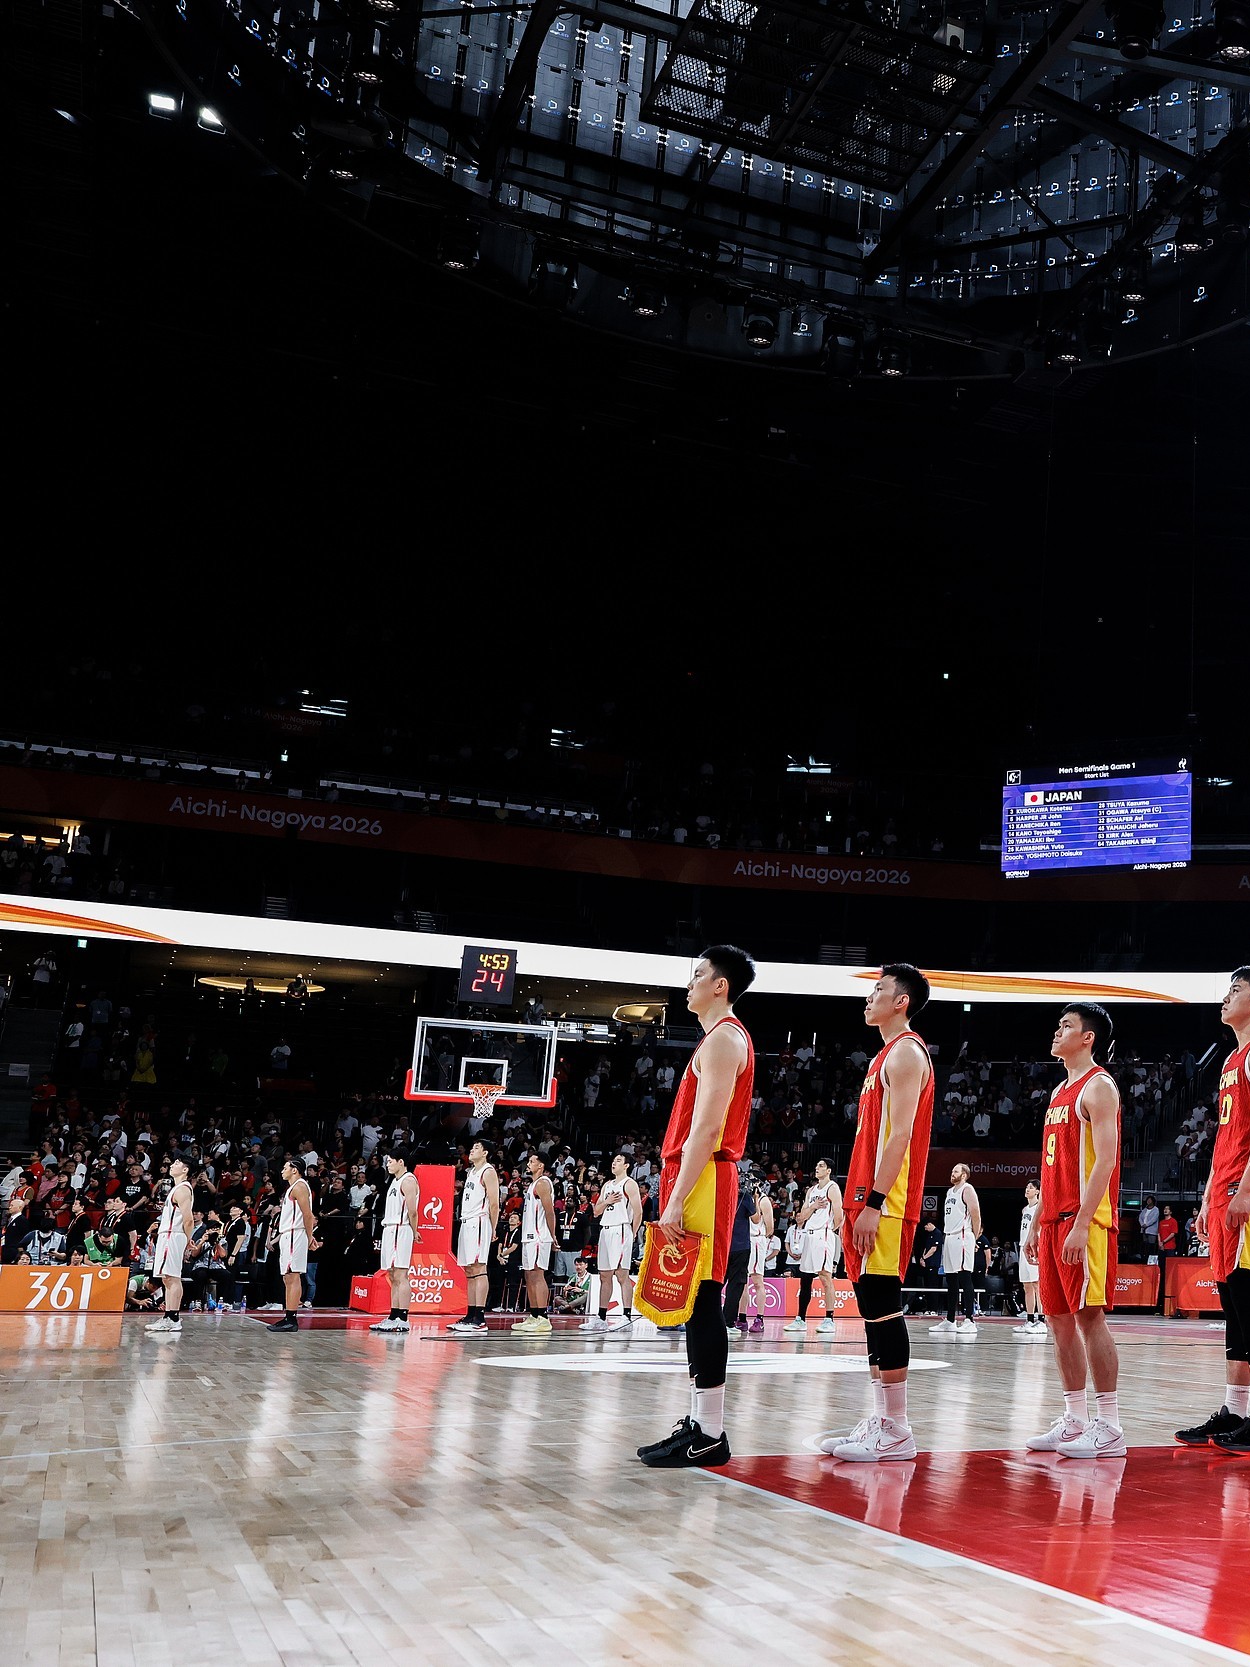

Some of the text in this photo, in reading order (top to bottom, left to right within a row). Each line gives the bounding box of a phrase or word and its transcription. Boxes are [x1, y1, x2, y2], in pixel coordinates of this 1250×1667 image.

[1110, 763, 1131, 771] Game
[1045, 791, 1082, 802] JAPAN
[169, 796, 383, 836] Aichi-Nagoya 2026
[733, 859, 911, 886] Aichi-Nagoya 2026
[479, 953, 509, 971] 4:53
[472, 970, 505, 993] 24
[971, 1163, 1038, 1176] ichi-Nagoya
[408, 1264, 449, 1276] Aichi-
[26, 1268, 111, 1309] 361°
[409, 1278, 454, 1290] agoya
[652, 1278, 683, 1290] TEAM CHINA
[653, 1286, 678, 1295] BASKETBALL
[410, 1292, 442, 1303] 2026
